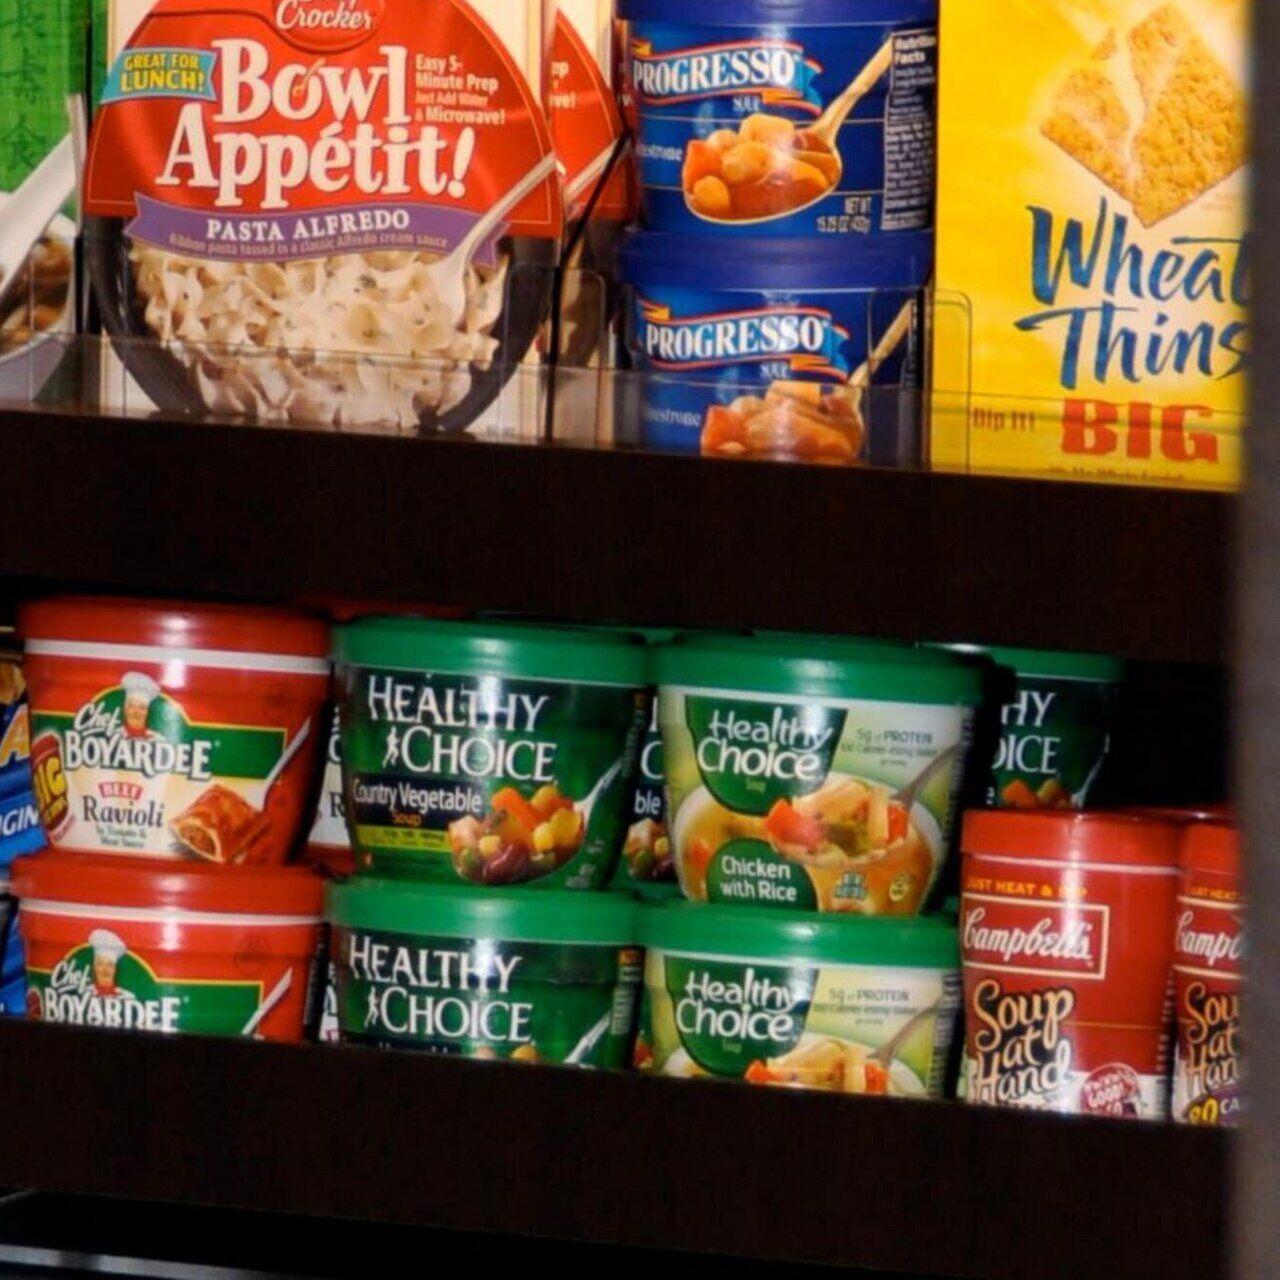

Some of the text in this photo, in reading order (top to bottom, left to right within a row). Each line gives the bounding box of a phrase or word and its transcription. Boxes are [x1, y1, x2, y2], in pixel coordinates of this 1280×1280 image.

[124, 51, 200, 72] GREAT FOR
[415, 53, 447, 74] Easy
[633, 52, 798, 98] PROGRESSO
[895, 51, 926, 65] Facts
[120, 69, 206, 92] LUNCH!
[211, 38, 411, 125] Bowl
[415, 72, 500, 95] Minute Prep
[425, 106, 505, 125] Microwave!
[155, 102, 475, 210] Appétit!
[206, 209, 410, 241] PASTA ALFREDO
[1027, 196, 1247, 308] Wheat
[646, 314, 827, 361] PROGRESSO
[1015, 303, 1248, 390] Thins
[971, 406, 1005, 432] Dip
[1060, 397, 1220, 464] BIG
[73, 702, 121, 736] Chef
[368, 674, 549, 732] HEALTHY
[708, 706, 834, 754] Healthy
[883, 729, 933, 745] PROTEIN
[65, 729, 212, 781] BOYARDEE
[401, 725, 558, 782] CHOICE
[696, 737, 820, 781] Choice
[82, 795, 166, 829] Ravioli
[353, 778, 483, 816] Country Vegetable
[721, 855, 792, 880] Chicken
[995, 880, 1053, 898] HEAT &
[720, 878, 798, 901] with Rice
[963, 907, 1093, 962] Campbell's
[50, 959, 92, 994] Chef
[349, 934, 523, 994] HEALTHY
[44, 990, 181, 1033] BOYARDEE
[684, 966, 798, 1014] Healthy
[857, 988, 909, 1004] PROTEIN
[380, 986, 534, 1042] CHOICE
[675, 998, 794, 1042] Choice
[973, 979, 1075, 1053] Soup
[1003, 1026, 1041, 1066] at
[976, 1037, 1073, 1108] Hand
